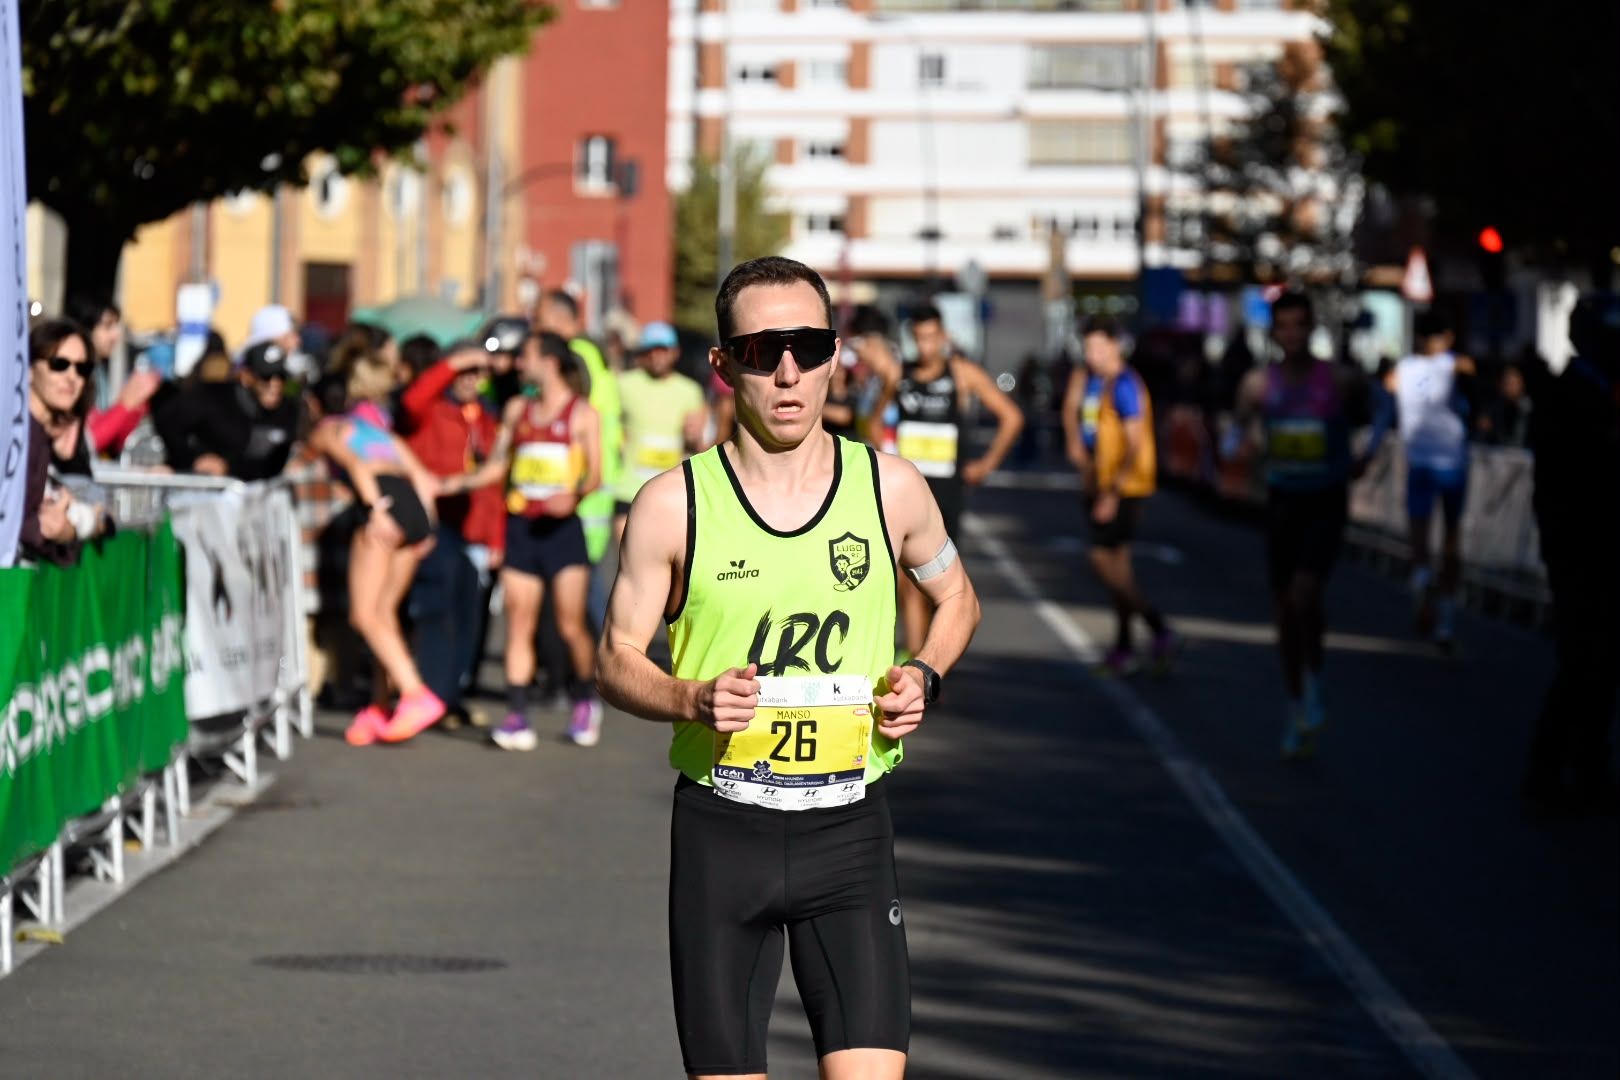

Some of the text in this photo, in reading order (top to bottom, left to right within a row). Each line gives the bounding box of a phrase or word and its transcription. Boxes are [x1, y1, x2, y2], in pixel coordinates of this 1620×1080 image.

[836, 544, 863, 552] LUGO
[716, 568, 760, 581] amura
[747, 608, 850, 677] LRC
[776, 710, 811, 719] MANSO
[769, 720, 817, 762] 26
